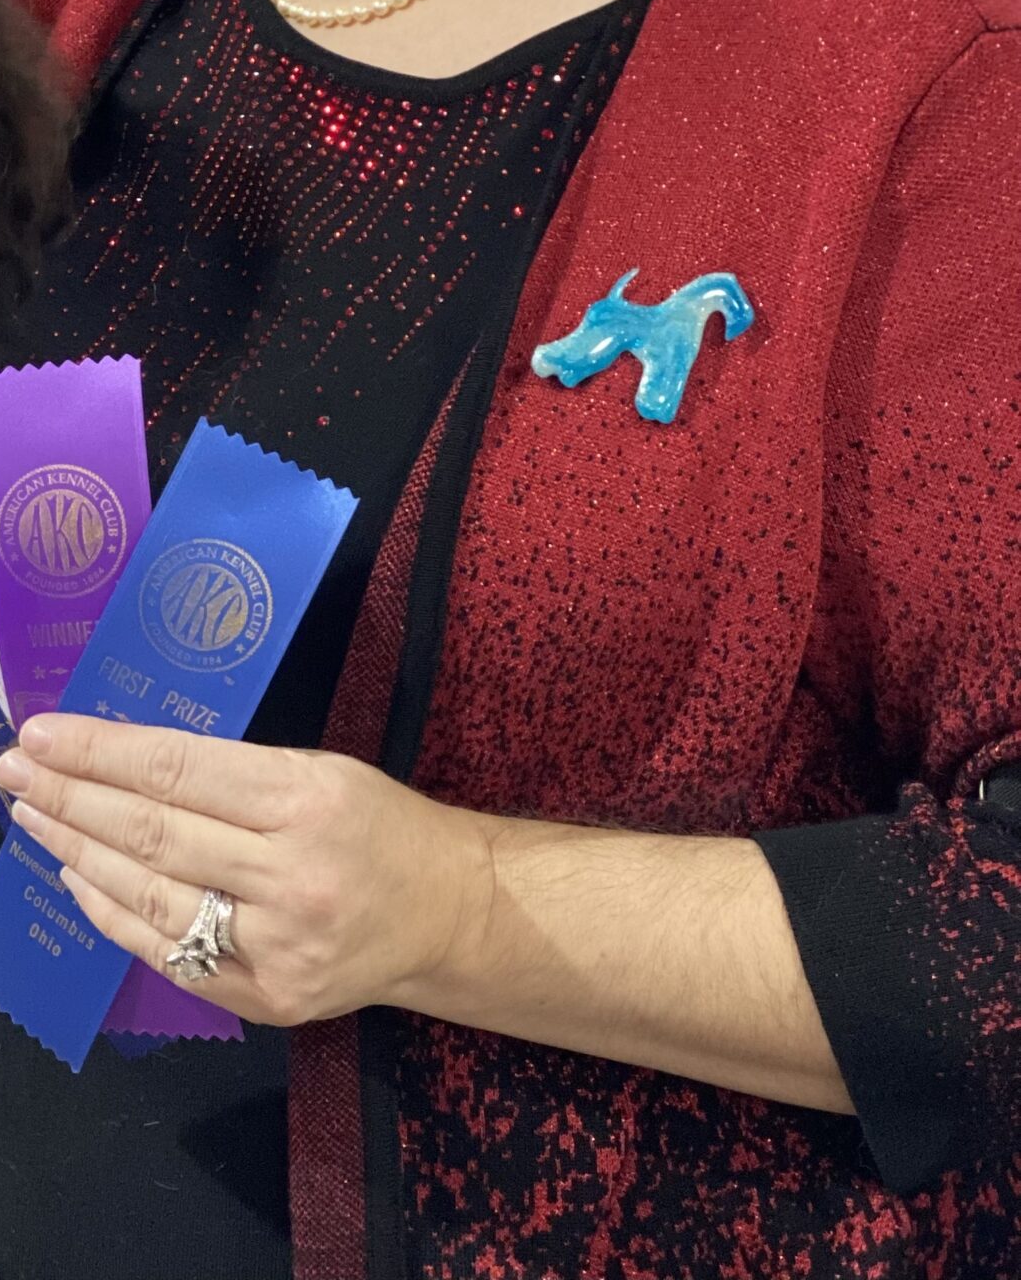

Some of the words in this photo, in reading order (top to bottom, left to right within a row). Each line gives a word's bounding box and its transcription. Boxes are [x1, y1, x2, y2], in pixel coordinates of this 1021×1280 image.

[3, 476, 45, 546] AMERICAN
[47, 472, 102, 501] KENNEL
[99, 498, 119, 538] CLUB
[21, 490, 103, 575] AKC
[25, 570, 80, 592] FOUNDED
[150, 546, 218, 592] AMERICAN
[220, 550, 264, 600] KENNEL
[244, 602, 266, 641] CLUB
[162, 564, 248, 651] AKC
[99, 655, 156, 699] FIRST
[160, 689, 221, 735] PRIZE
[9, 839, 68, 896] November
[23, 885, 96, 951] Columbus
[28, 922, 62, 957] Ohio
